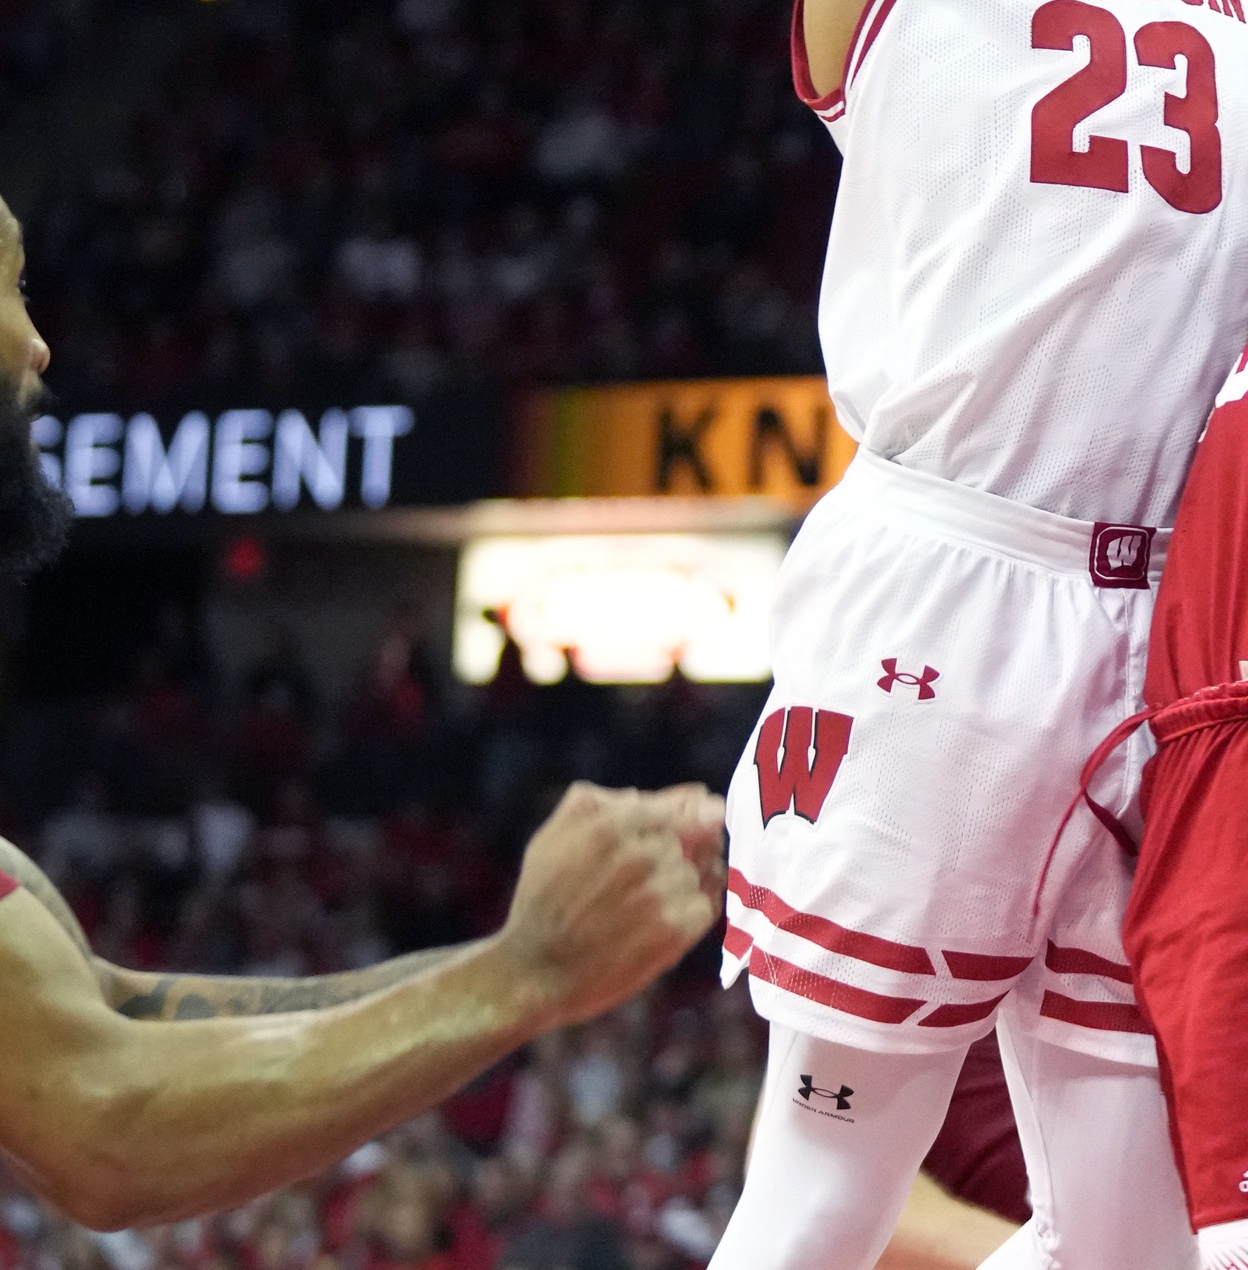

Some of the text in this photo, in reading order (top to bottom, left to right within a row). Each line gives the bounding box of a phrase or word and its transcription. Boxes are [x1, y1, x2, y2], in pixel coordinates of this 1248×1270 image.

[657, 402, 830, 496] KN
[753, 705, 855, 830] W
[792, 1097, 855, 1124] UNDER ARMOUR
